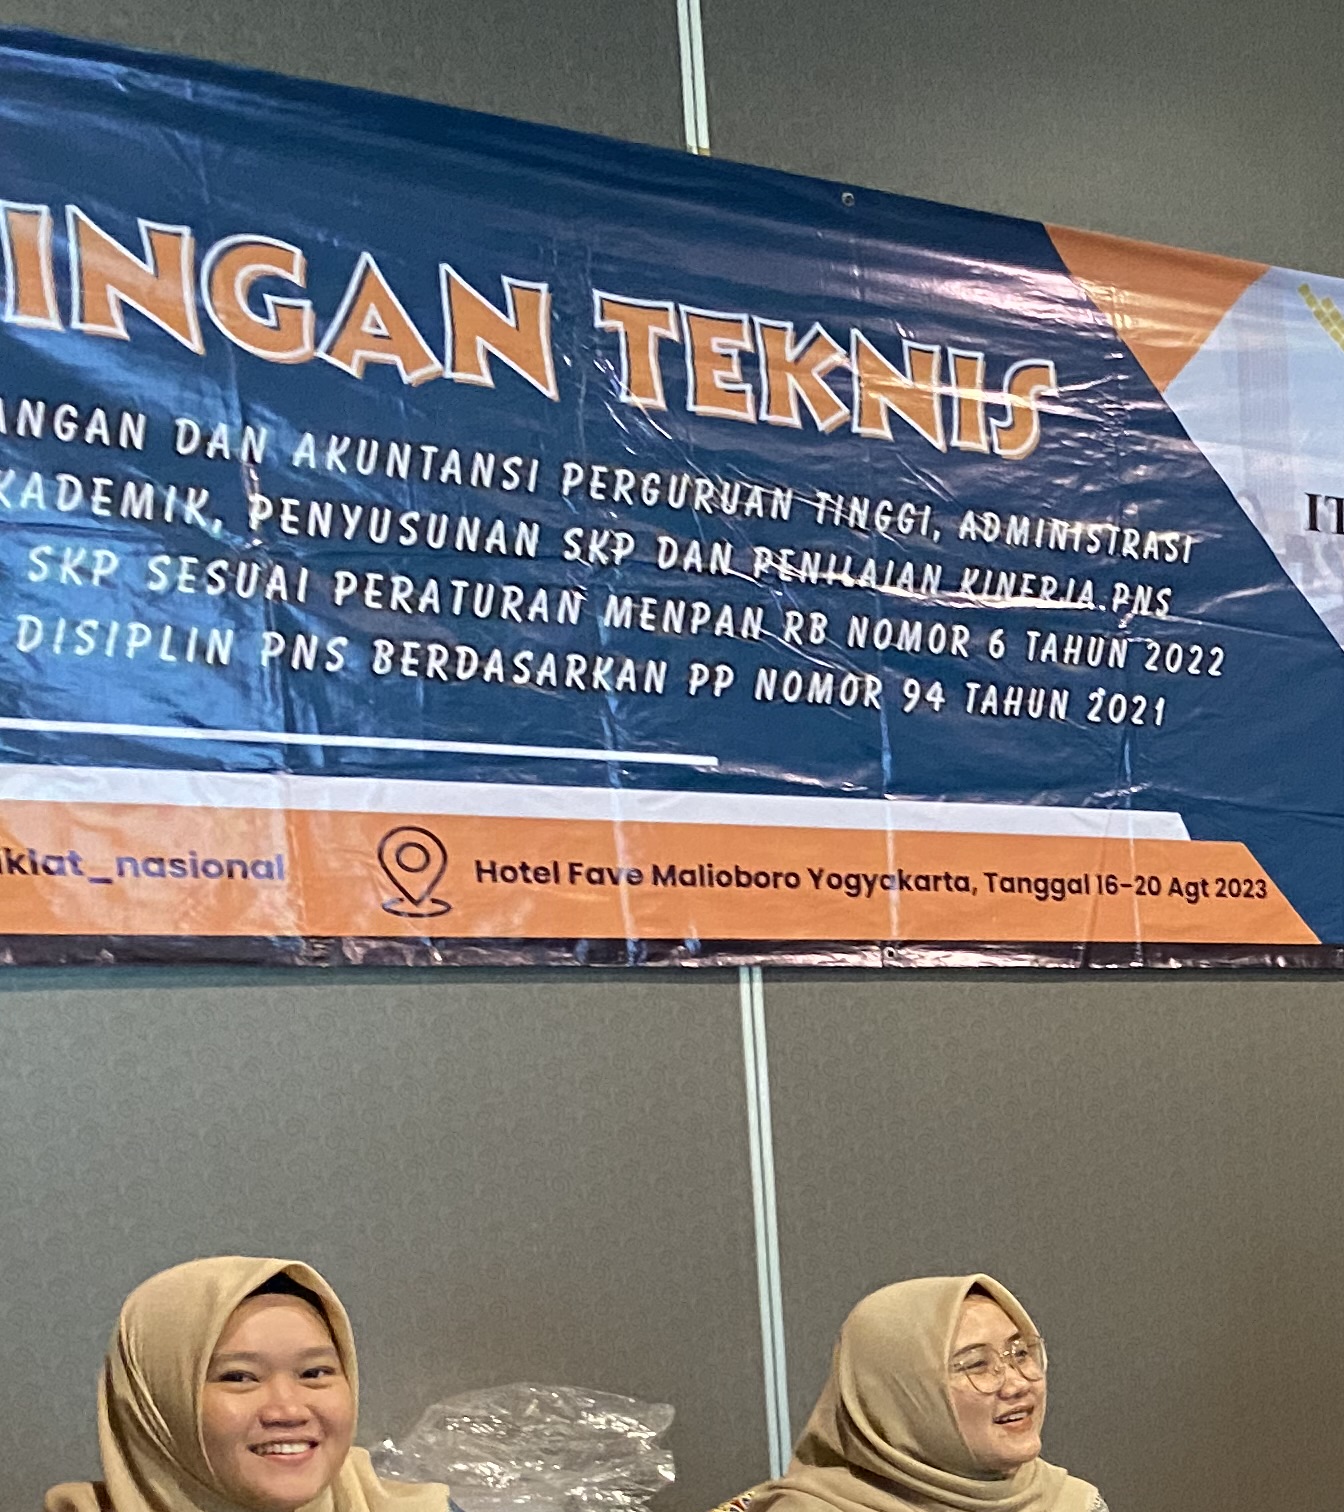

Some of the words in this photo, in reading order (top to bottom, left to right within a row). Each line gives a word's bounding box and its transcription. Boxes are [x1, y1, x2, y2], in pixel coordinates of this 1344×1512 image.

[0, 202, 559, 401] INGAN
[592, 289, 1058, 460] TEKNIS
[175, 417, 268, 463] DAN
[291, 433, 541, 494] AKUNTANSI
[562, 461, 793, 522] PERGURUAN
[814, 491, 940, 540] TINGGI,
[958, 510, 1193, 564] ADMINISTRASI
[27, 545, 118, 587] SKP
[148, 555, 308, 604] SESUAI
[334, 570, 582, 625] PERATURAN
[603, 594, 764, 641] MENPAN
[783, 611, 828, 645] RB
[847, 616, 971, 659] NOMOR
[988, 628, 1006, 660] 6
[1026, 630, 1130, 670] TAHUN
[1145, 641, 1226, 677] 2022
[249, 494, 541, 558] PENYUSUNAN
[563, 527, 635, 567] SKP
[657, 535, 733, 577] DAN
[752, 546, 943, 597] PENILAIAN
[1111, 583, 1173, 619] PNS
[16, 614, 235, 667] DISIPLIN
[260, 632, 349, 673] PNS
[372, 640, 668, 695] BERDASARKAN
[688, 663, 736, 698] PP
[754, 671, 884, 710] NOMOR
[902, 678, 947, 713] 94
[965, 683, 1070, 724] TAHUN
[1087, 690, 1166, 728] 2021
[474, 859, 562, 886] Hotel
[569, 862, 643, 887] Fave
[651, 863, 801, 891] Malioboro
[808, 867, 978, 899] Yogyakarta,
[984, 871, 1090, 902] Tanggal
[1096, 874, 1163, 899] 16-20
[1168, 877, 1210, 905] Agt
[1214, 878, 1268, 900] 2023
